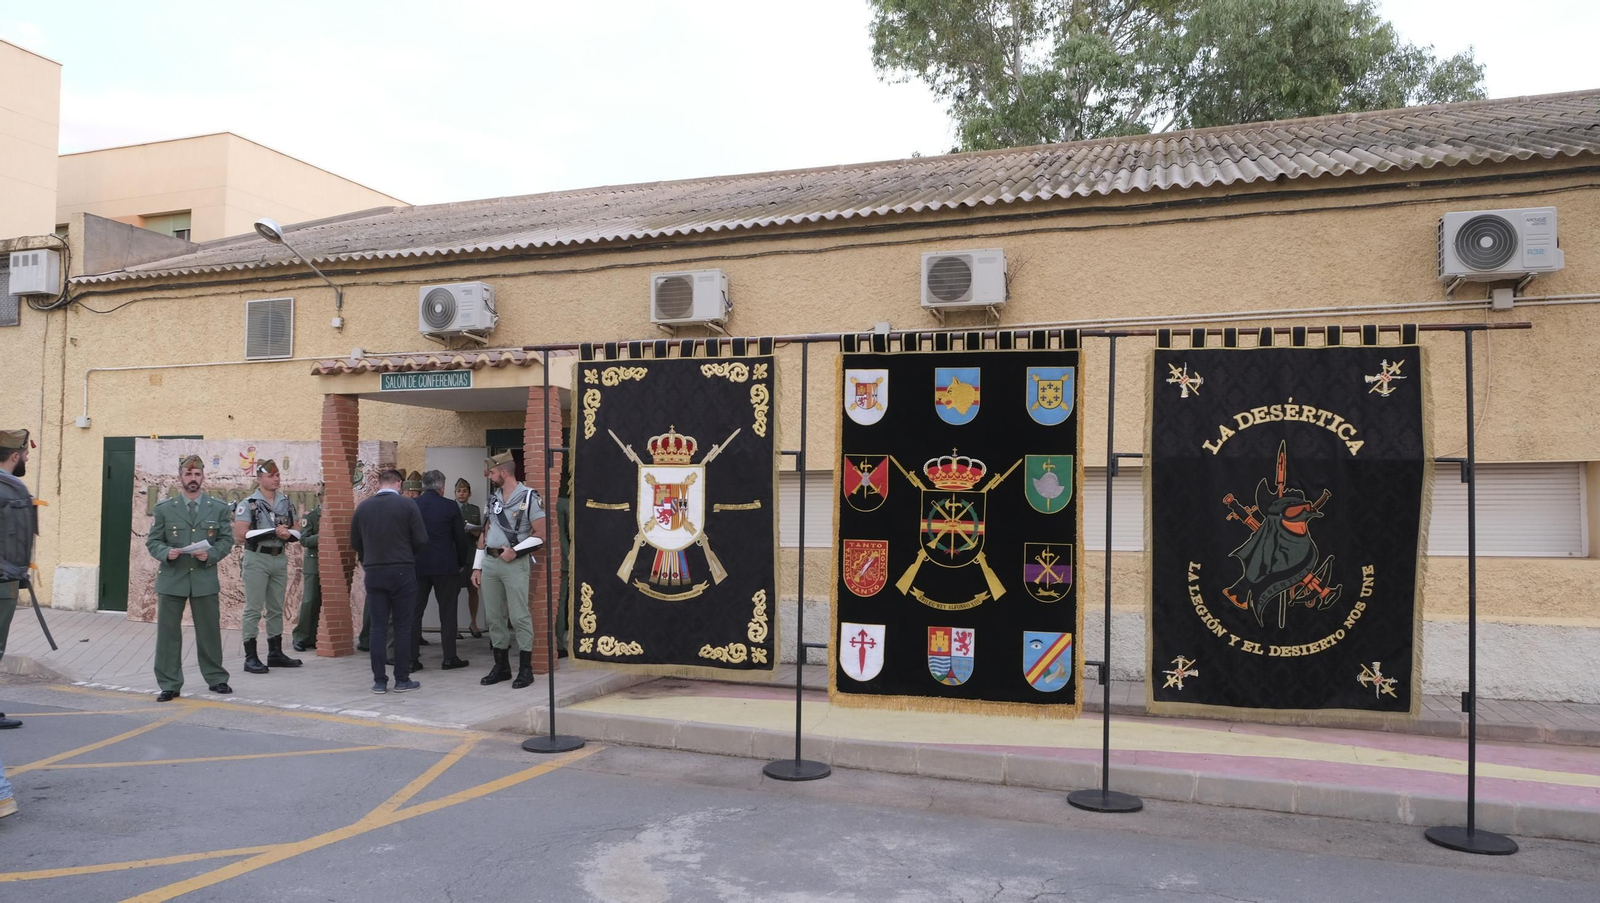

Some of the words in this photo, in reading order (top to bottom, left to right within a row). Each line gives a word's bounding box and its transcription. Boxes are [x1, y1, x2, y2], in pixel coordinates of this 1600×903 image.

[408, 375, 417, 388] DE
[418, 373, 468, 388] CONFERENCIAS
[1202, 424, 1235, 455] LA
[1233, 396, 1365, 456] DESÉRTICA
[1188, 561, 1201, 582] LA
[1360, 564, 1375, 598] UNE
[851, 583, 880, 594] TANTO
[948, 602, 970, 610] ALFONSO
[1188, 584, 1228, 638] LEGIÓN
[1344, 601, 1366, 629] NOS
[1228, 633, 1241, 647] Y
[1241, 640, 1264, 655] EL
[1268, 629, 1345, 657] DESIERTO
